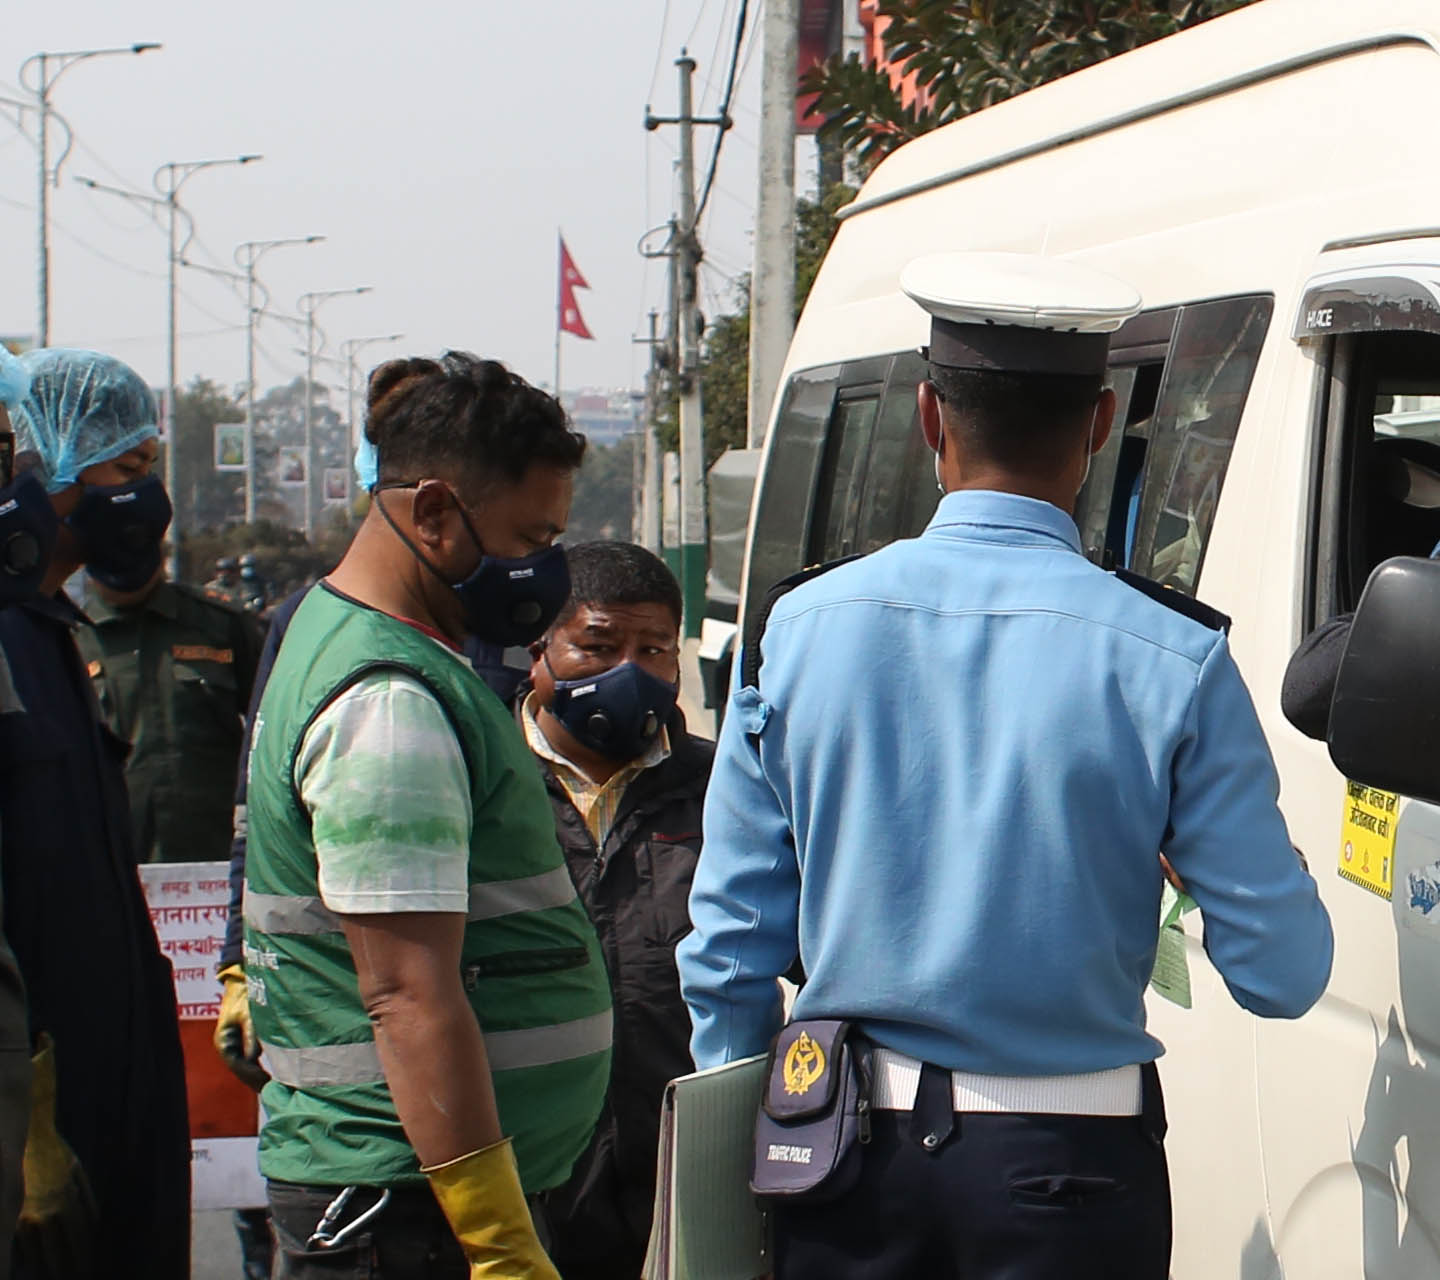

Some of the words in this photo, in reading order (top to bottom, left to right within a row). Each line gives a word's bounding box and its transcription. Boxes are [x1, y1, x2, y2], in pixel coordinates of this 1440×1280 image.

[1306, 309, 1333, 328] HIACE
[767, 1145, 789, 1161] TRAFFIC
[789, 1146, 812, 1163] POLICE
